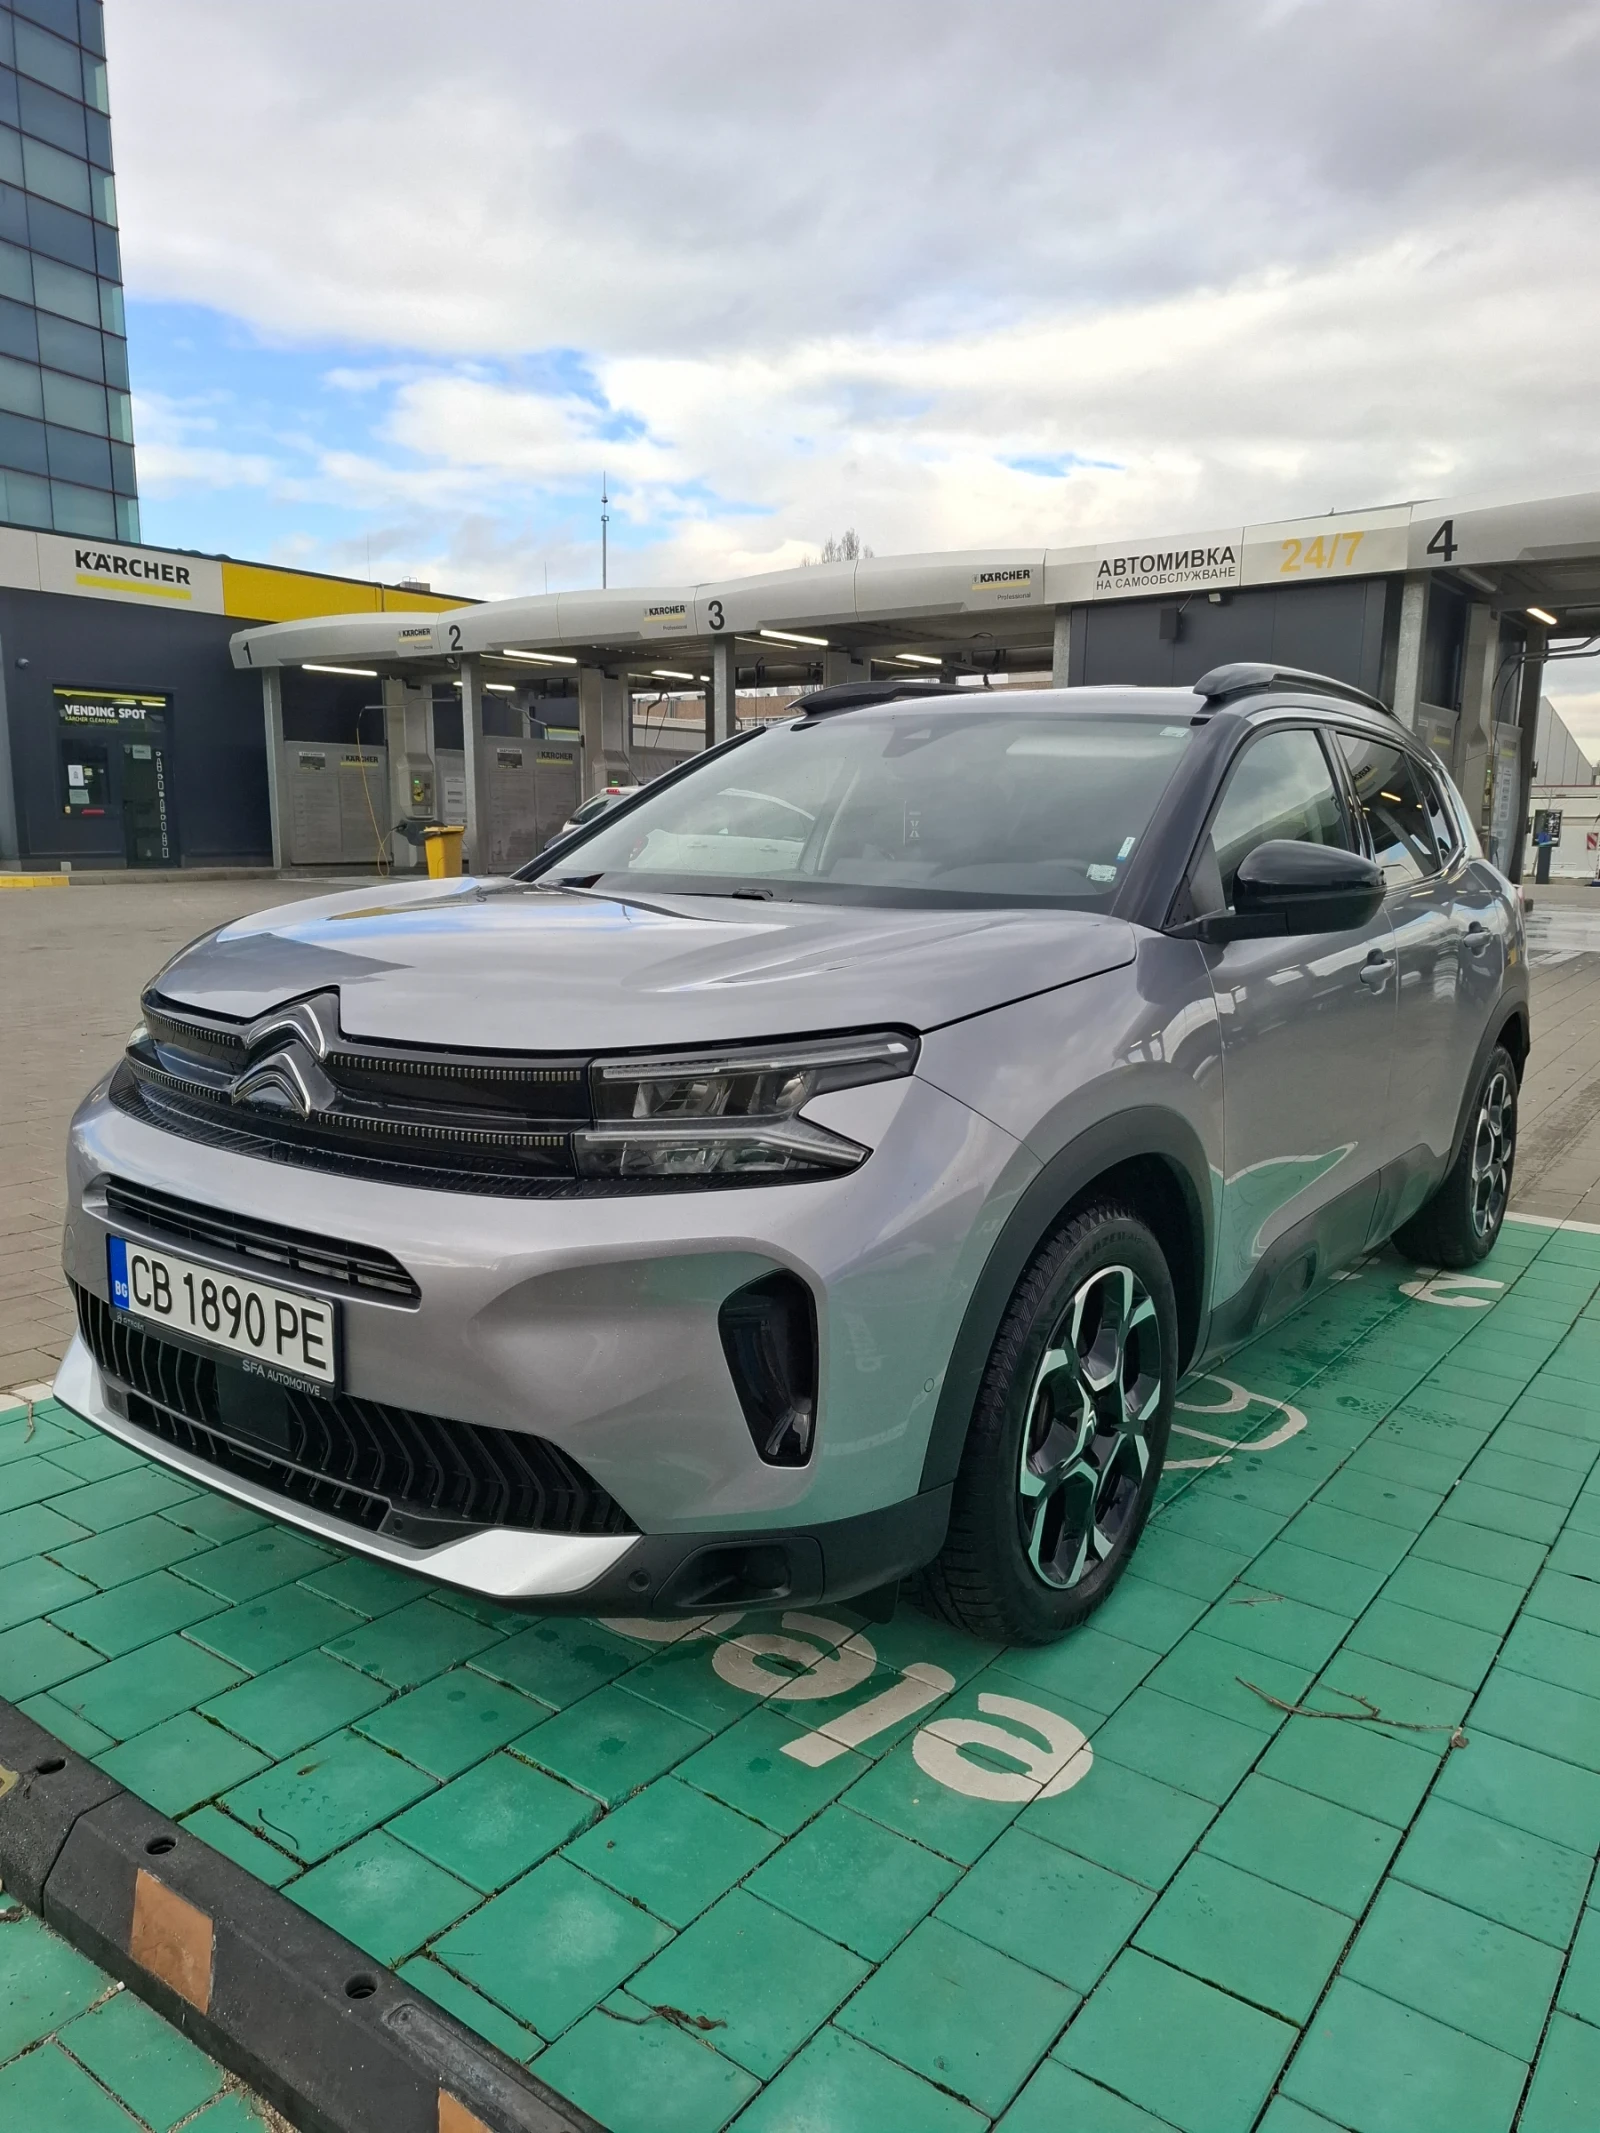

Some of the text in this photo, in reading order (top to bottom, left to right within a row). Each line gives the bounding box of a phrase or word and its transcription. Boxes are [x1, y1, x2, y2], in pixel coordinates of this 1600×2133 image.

[1280, 530, 1364, 573] 24/7
[1426, 519, 1458, 562] 4
[75, 549, 191, 585] KÄRCHER
[1098, 545, 1236, 578] АВТОМИВКА
[1096, 566, 1236, 590] НА САМООБСЛУЖВАНЕ
[708, 600, 725, 631] 3
[243, 641, 253, 665] 1
[448, 624, 464, 651] 2
[64, 704, 146, 719] VENDING SPOT
[115, 1280, 128, 1298] BG
[131, 1254, 327, 1370] CB 1890 PE
[242, 1360, 320, 1396] SFA AUTOMOTIVE
